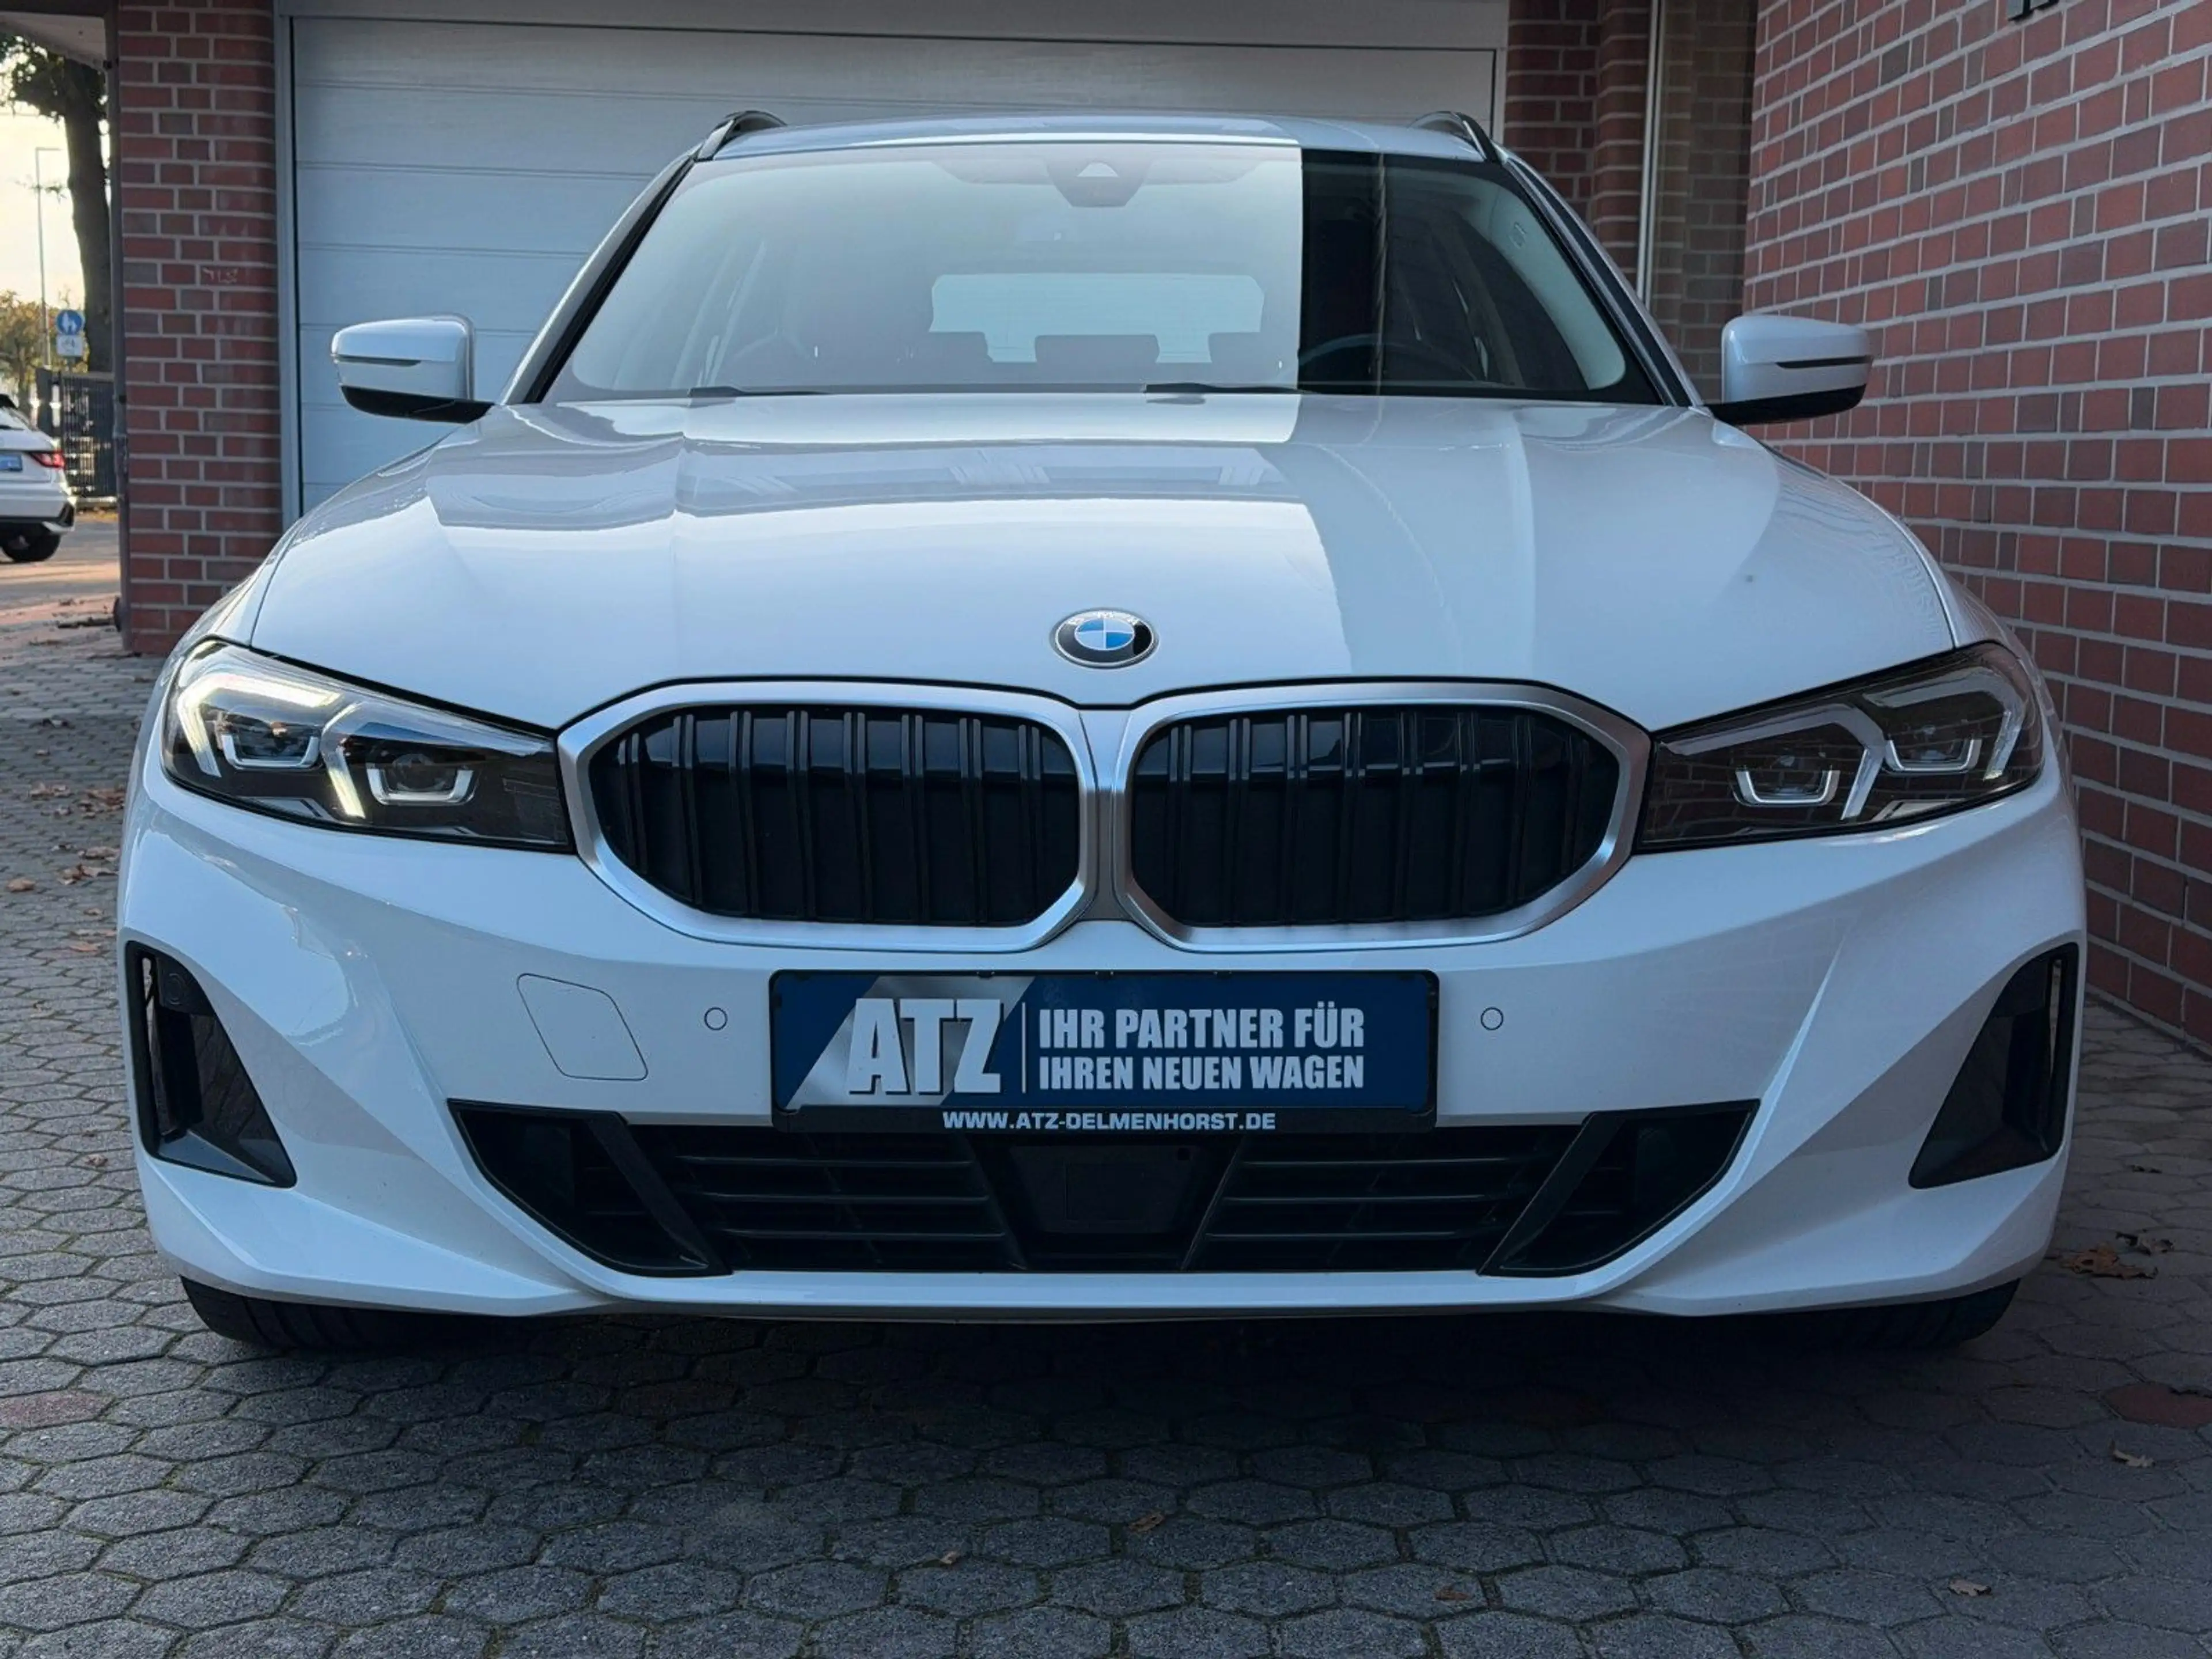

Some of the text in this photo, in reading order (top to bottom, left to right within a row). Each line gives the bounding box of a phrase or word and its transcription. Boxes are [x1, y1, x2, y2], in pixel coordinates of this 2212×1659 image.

[1039, 1001, 1365, 1048] IHR PARTNER FÜR
[846, 998, 1001, 1094] ATZ
[1039, 1055, 1364, 1090] IHREN NEUEN WAGEN
[942, 1111, 1277, 1130] WWW.ATZ-DELMENHORST.DE
